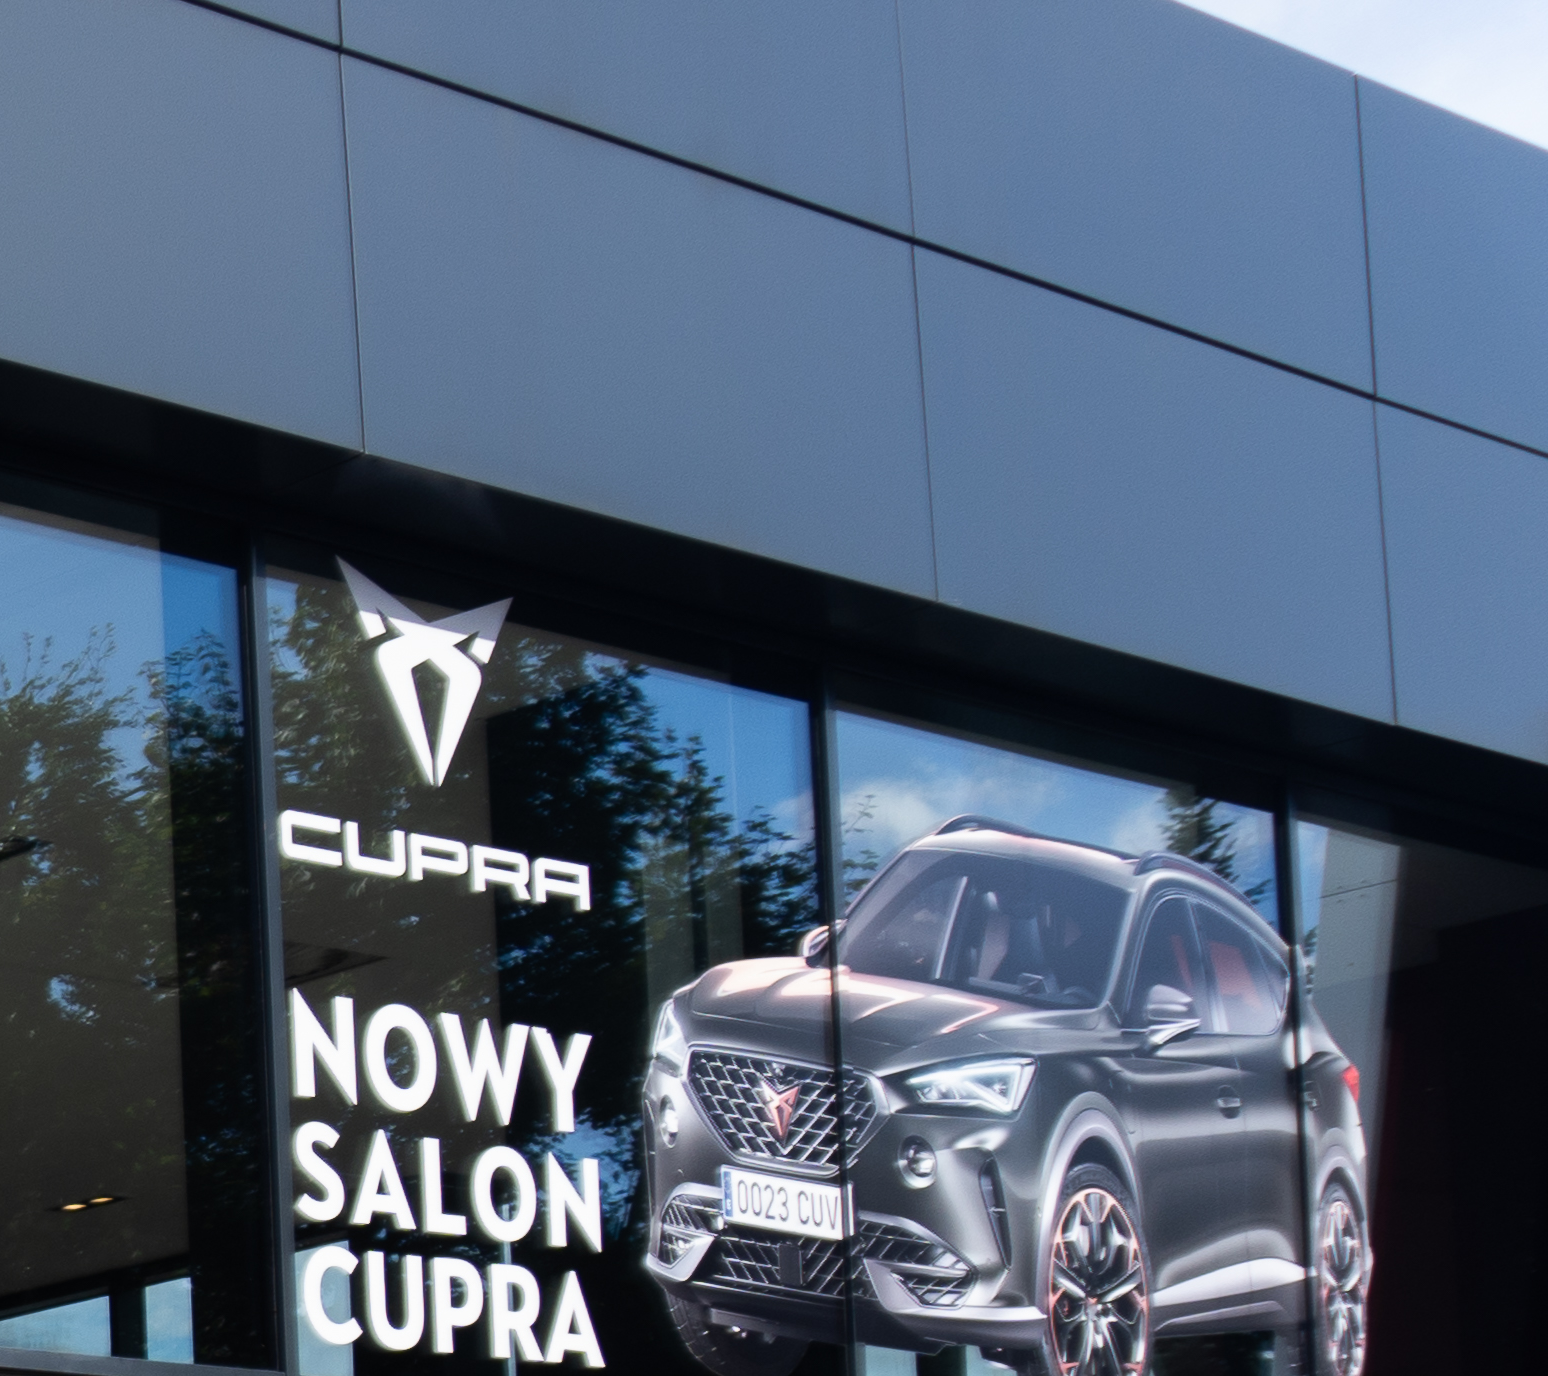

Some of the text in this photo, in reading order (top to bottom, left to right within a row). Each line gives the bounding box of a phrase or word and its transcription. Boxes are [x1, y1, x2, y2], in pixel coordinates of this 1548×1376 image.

[278, 809, 591, 911] CUPRA
[290, 987, 592, 1133] NOWY
[293, 1120, 603, 1254] SALON
[737, 1179, 839, 1231] 0023 CUV
[300, 1245, 606, 1369] CUPRA
